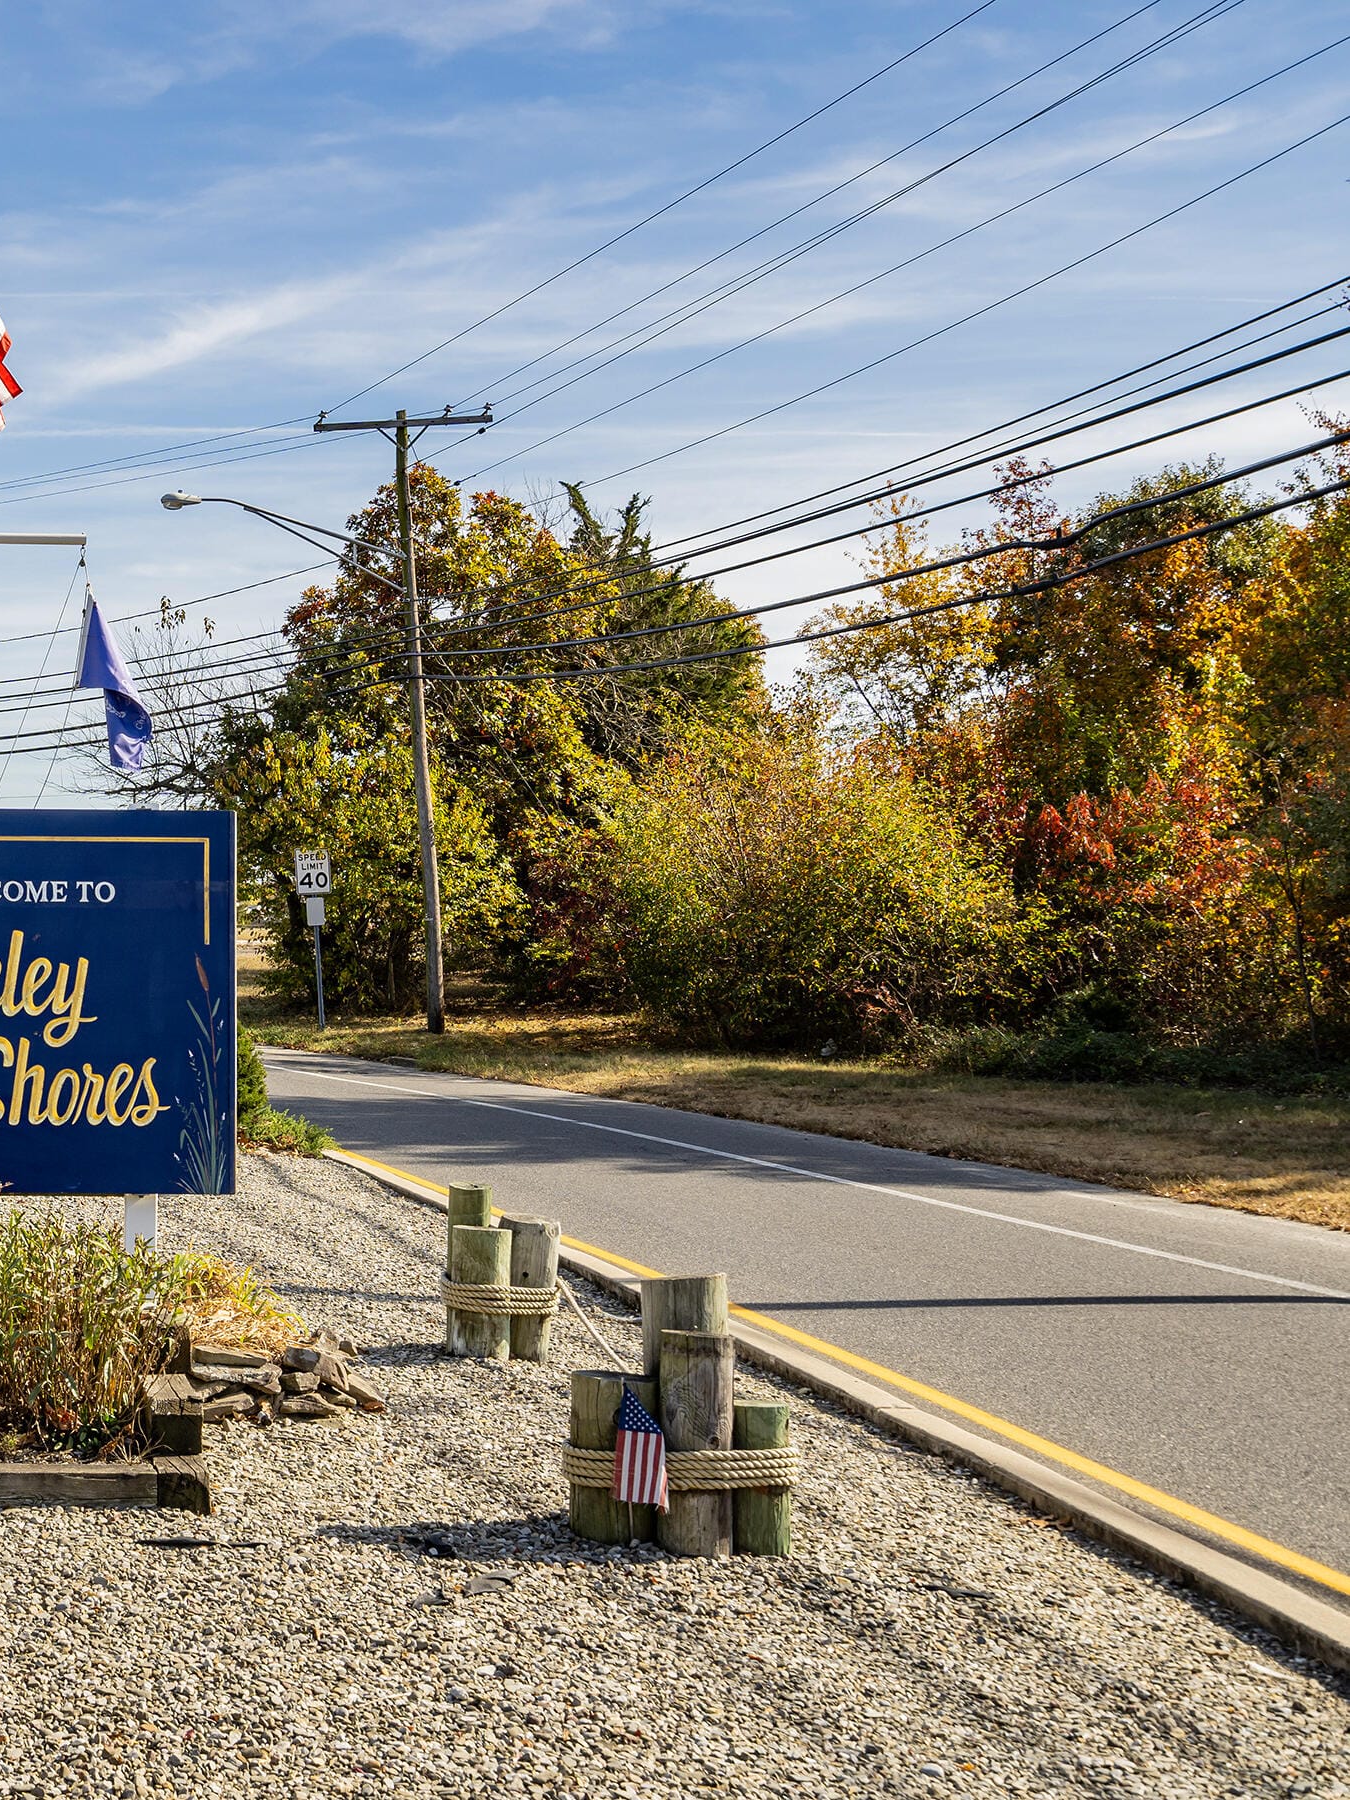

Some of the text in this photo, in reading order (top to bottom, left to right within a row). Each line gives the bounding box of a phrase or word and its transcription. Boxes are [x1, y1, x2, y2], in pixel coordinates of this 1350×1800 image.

[298, 853, 327, 862] SPEED
[301, 862, 324, 871] LIMIT
[299, 872, 328, 889] 40
[76, 881, 116, 903] TO
